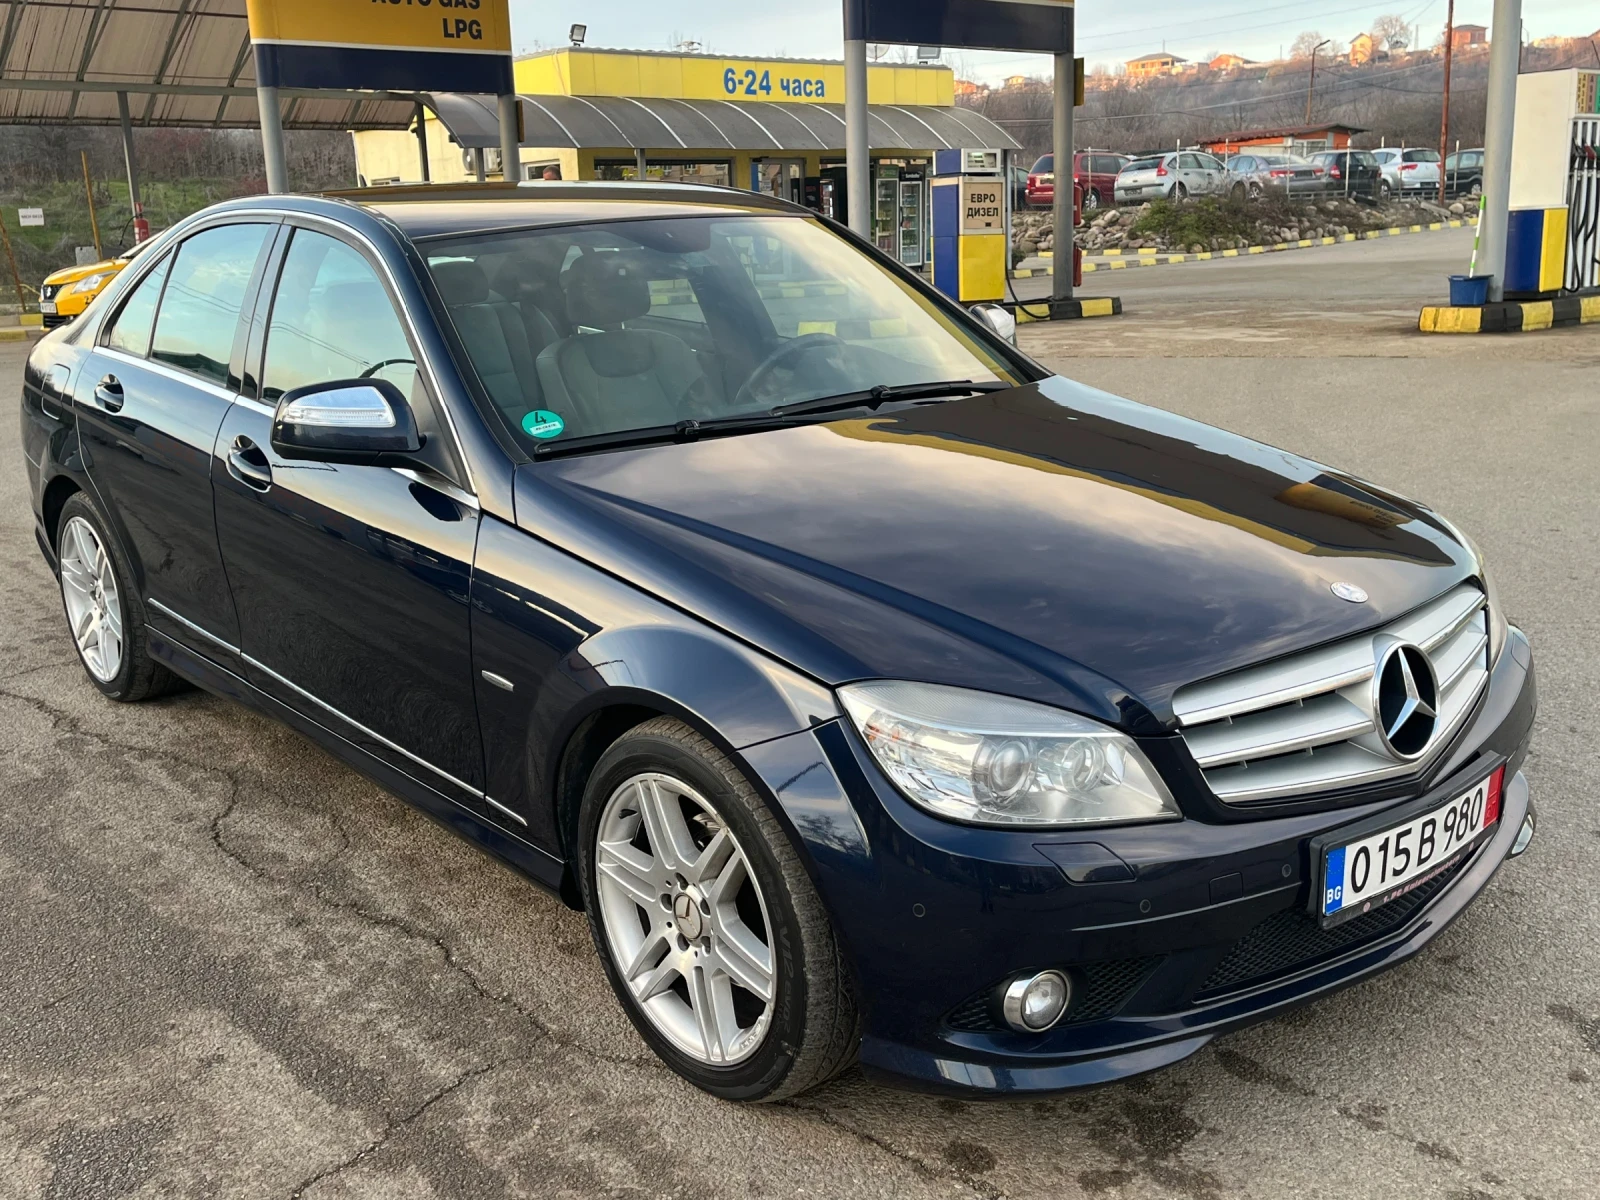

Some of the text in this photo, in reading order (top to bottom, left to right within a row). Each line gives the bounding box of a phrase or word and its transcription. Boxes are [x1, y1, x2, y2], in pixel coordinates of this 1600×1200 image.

[442, 18, 482, 39] LPG
[724, 67, 825, 97] 6-24 часа
[971, 193, 996, 203] ЕВРО
[967, 207, 999, 218] ДИЗЕЛ
[535, 412, 546, 423] 4
[1326, 888, 1342, 905] BG
